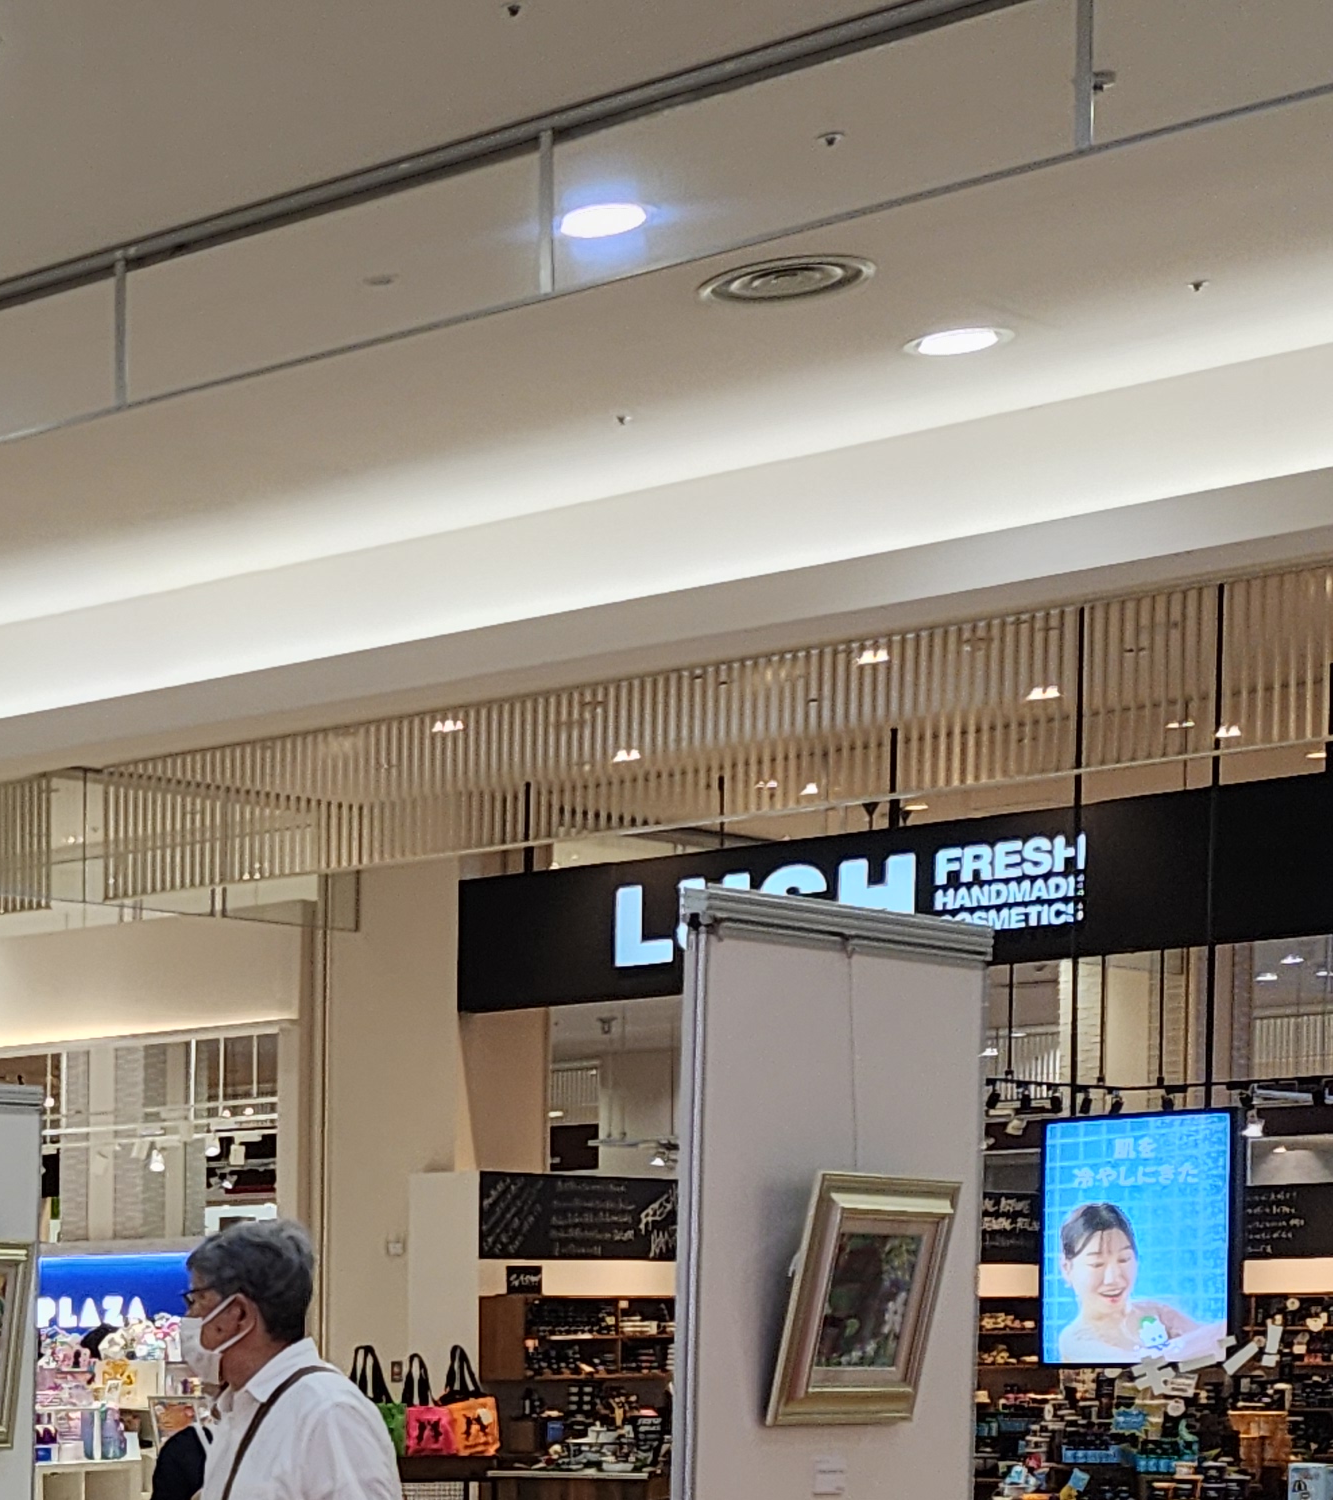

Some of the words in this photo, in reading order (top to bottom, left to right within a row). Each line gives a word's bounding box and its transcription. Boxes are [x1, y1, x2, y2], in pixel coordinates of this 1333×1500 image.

[614, 852, 916, 967] LH
[935, 832, 1087, 886] FRESH
[1114, 1137, 1158, 1159] 肌を
[1072, 1162, 1199, 1189] 冷やしにきた
[36, 1295, 147, 1328] PLAZA
